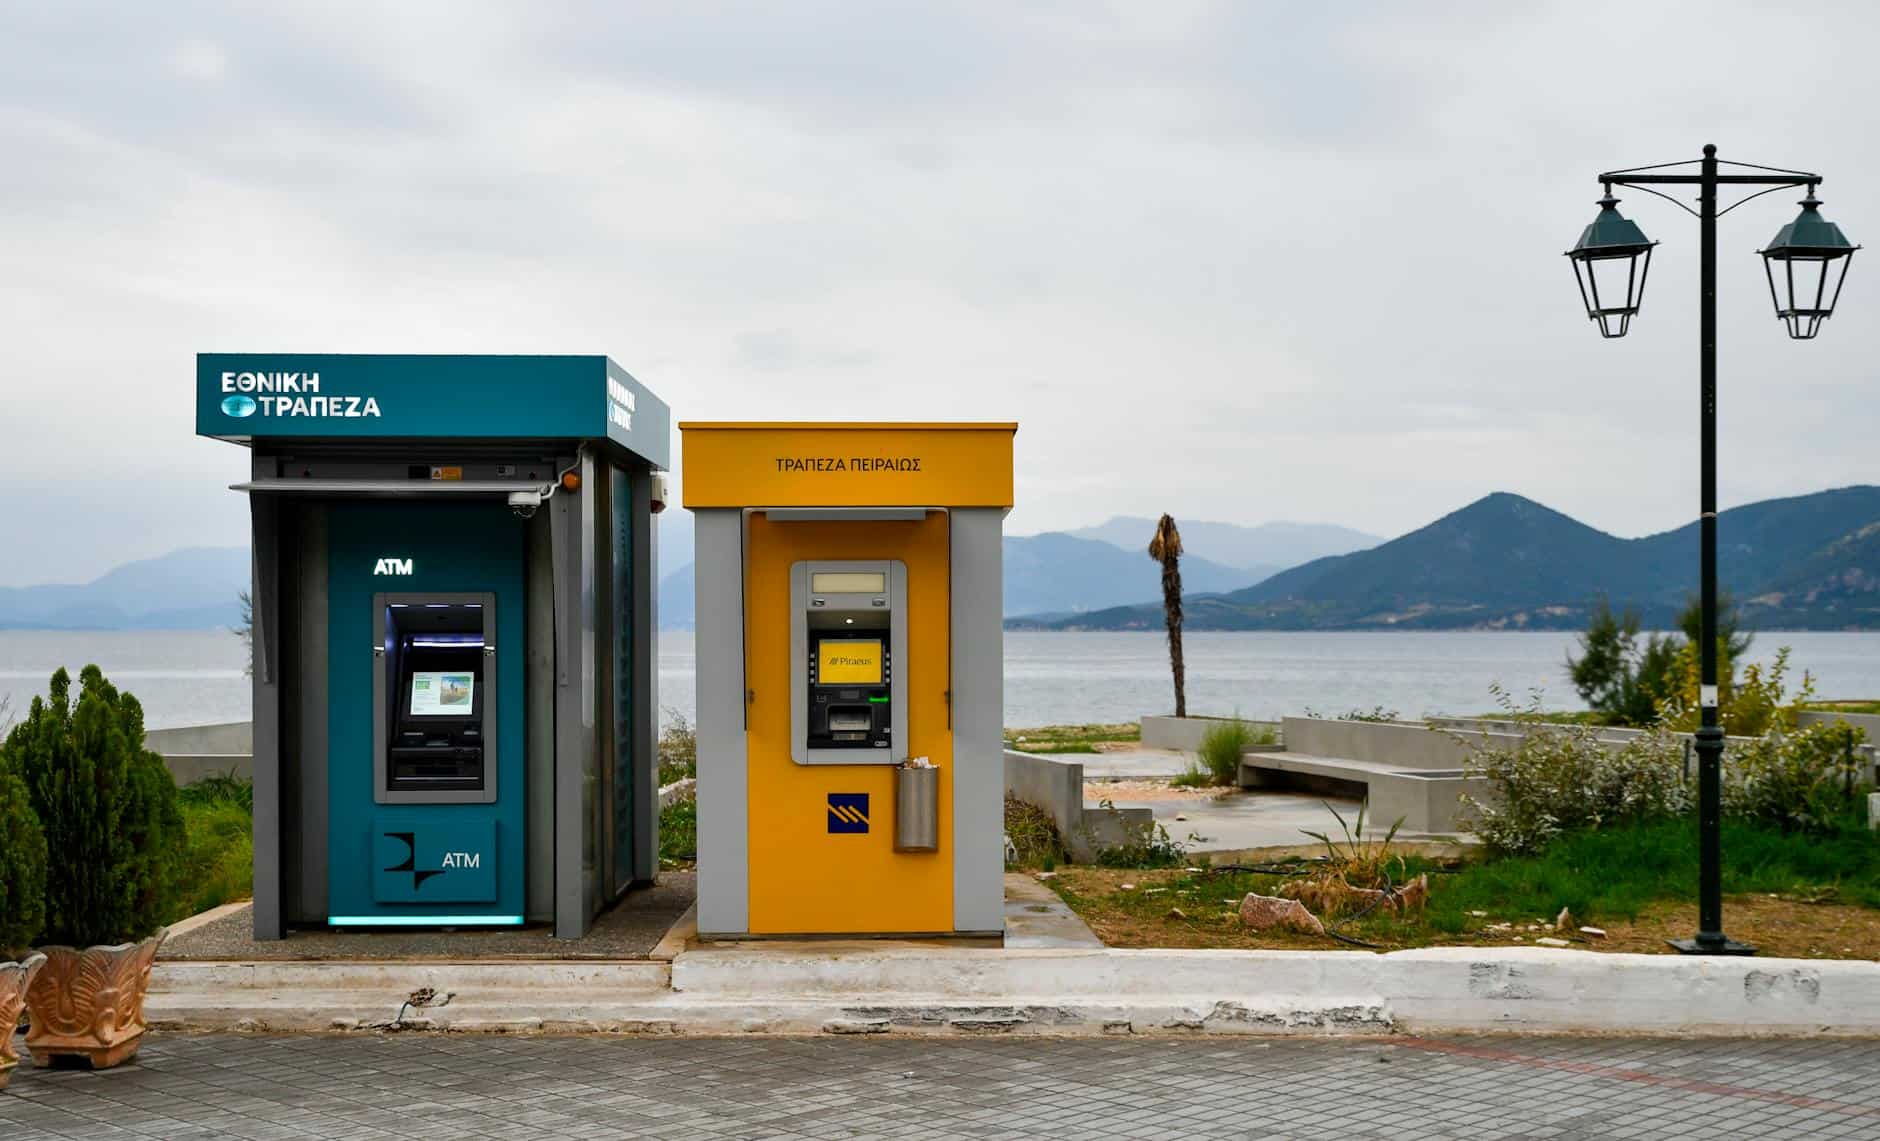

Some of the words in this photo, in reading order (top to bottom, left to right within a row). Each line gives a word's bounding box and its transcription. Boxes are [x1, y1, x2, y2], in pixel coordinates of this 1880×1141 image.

[221, 371, 320, 393] ΕΘΝΙΚΗ
[257, 395, 382, 418] ΤΡΑΠΕΖΑ
[776, 458, 846, 472] ΤΡΑΠΕΖΑ
[850, 458, 921, 472] ΠΕΙΡΑΙΩΣ
[373, 558, 413, 576] ATM
[442, 852, 480, 868] ATM
